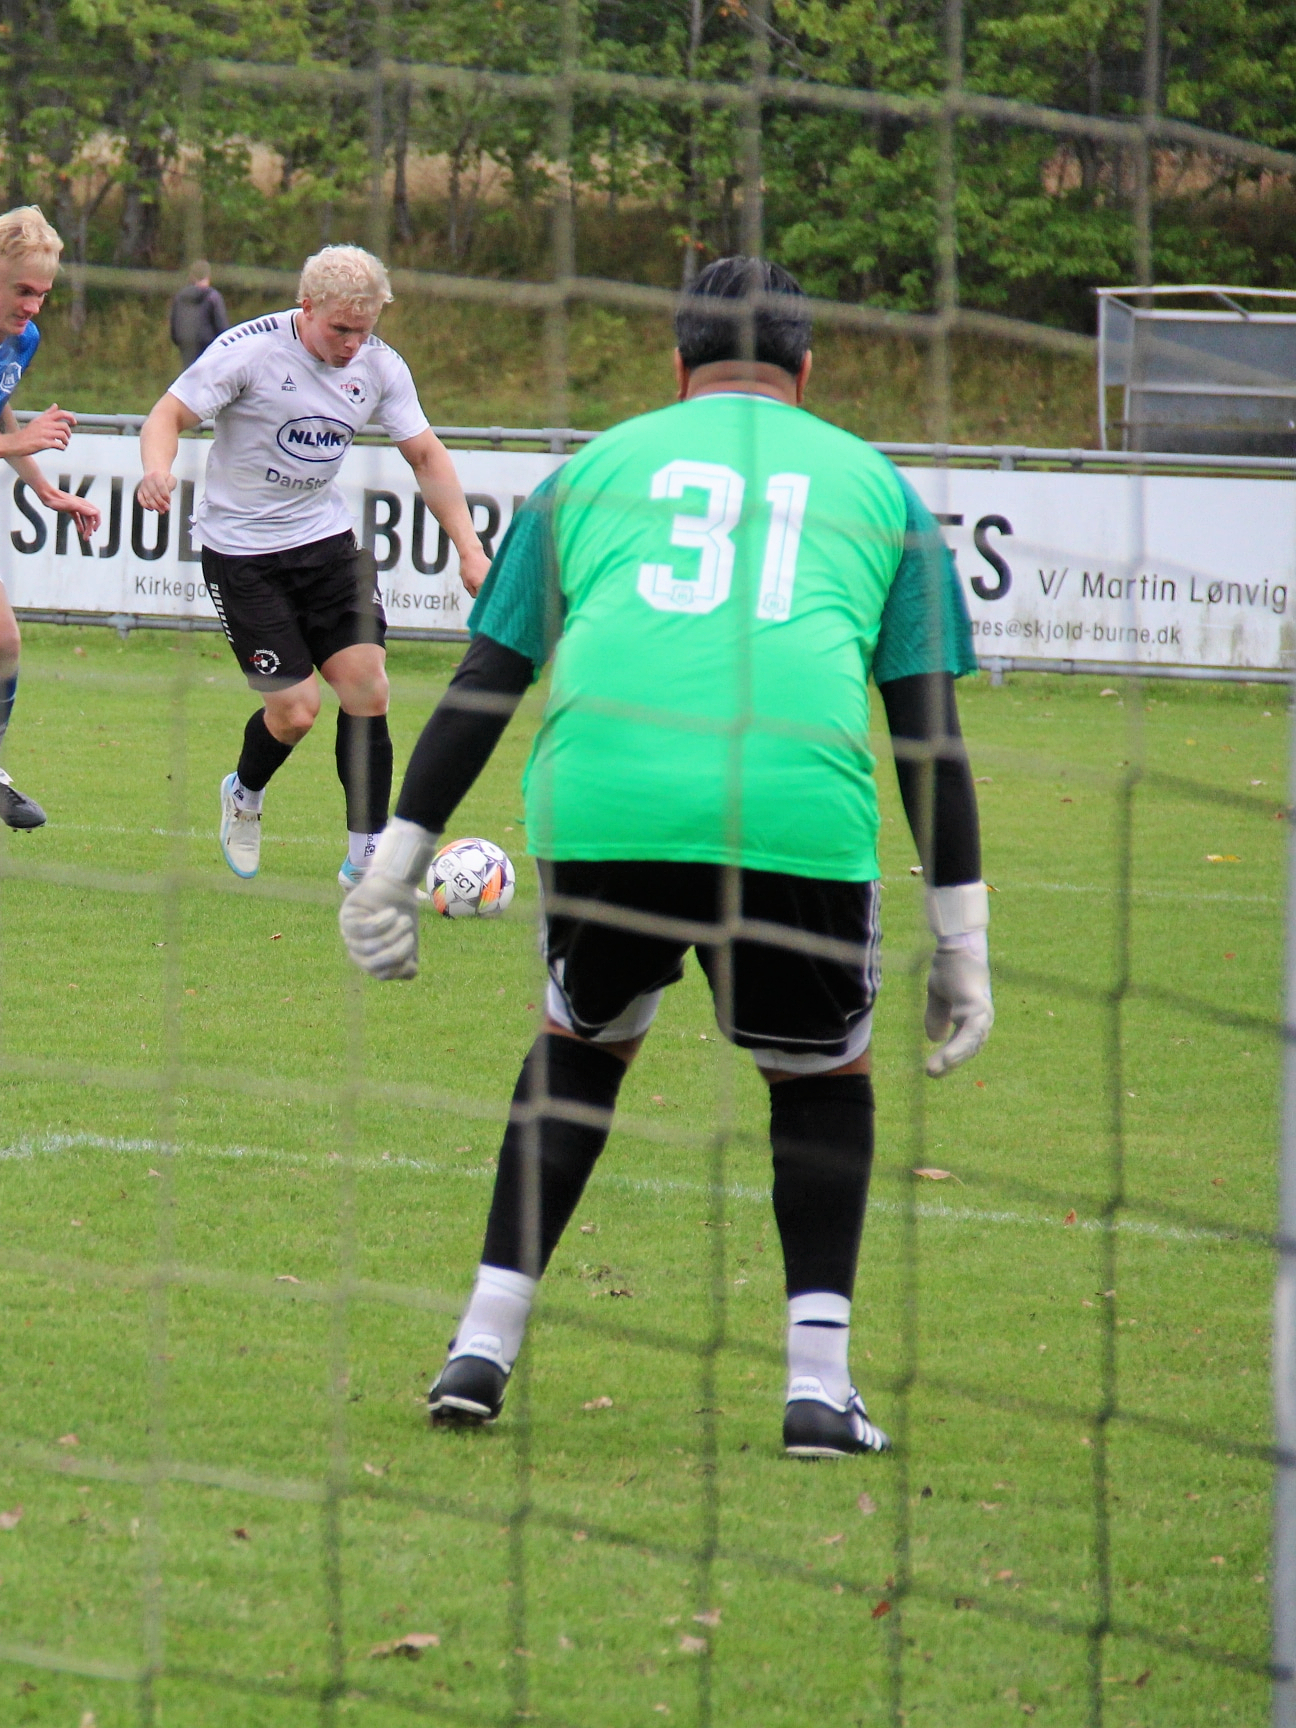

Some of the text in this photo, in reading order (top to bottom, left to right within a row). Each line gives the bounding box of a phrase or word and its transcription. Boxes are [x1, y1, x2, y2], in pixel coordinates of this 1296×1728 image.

[287, 428, 347, 448] NLMK
[10, 472, 203, 562] SKJOL
[1082, 571, 1177, 602] Martin
[1190, 575, 1289, 614] Lønvig
[636, 459, 811, 622] 31
[440, 858, 477, 894] SELECT
